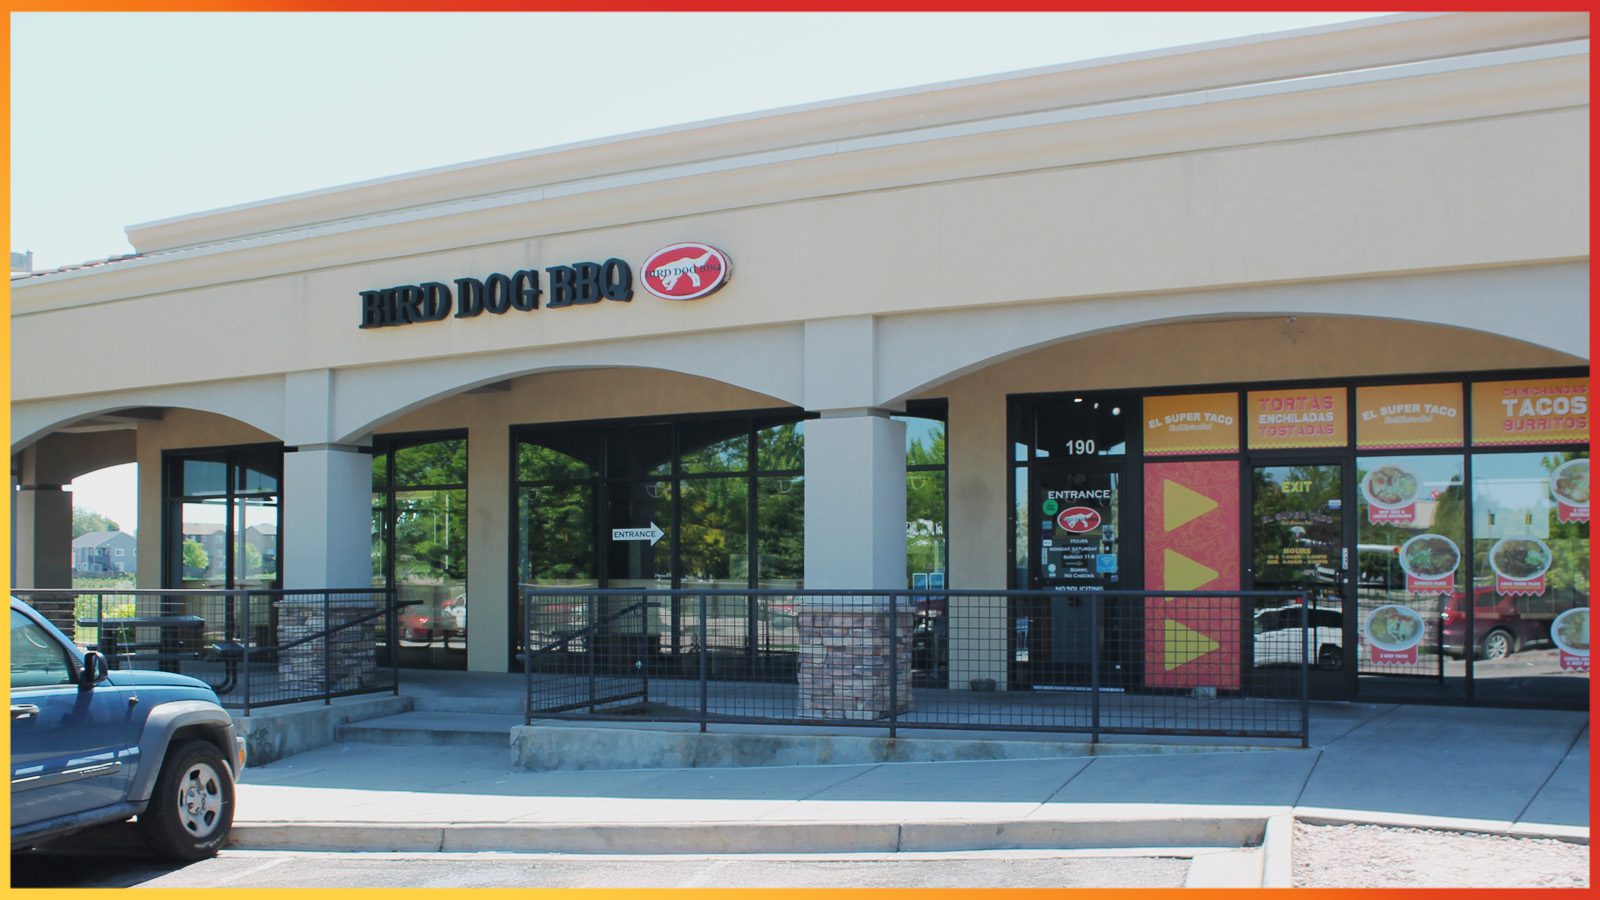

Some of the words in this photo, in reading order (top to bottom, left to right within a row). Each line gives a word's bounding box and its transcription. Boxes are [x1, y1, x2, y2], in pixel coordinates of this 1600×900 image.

[359, 281, 452, 329] BIRD
[453, 269, 543, 319] DOG
[545, 257, 634, 308] BBQ
[1259, 396, 1335, 412] TORTAS
[1361, 409, 1378, 421] EL
[1379, 403, 1421, 417] SUPER
[1423, 403, 1457, 417] TACO
[1502, 396, 1588, 417] TACOS
[1148, 418, 1163, 430] EL
[1164, 411, 1201, 424] SUPER
[1203, 411, 1233, 426] TACO
[1258, 411, 1335, 424] ENCHILADAS
[1503, 416, 1588, 432] BURRITOS
[1258, 423, 1336, 438] TOSTADAS
[1065, 439, 1096, 455] 190
[1047, 489, 1111, 499] ENTRANCE
[1281, 481, 1312, 493] EXIT
[613, 530, 657, 538] ENTRANCE
